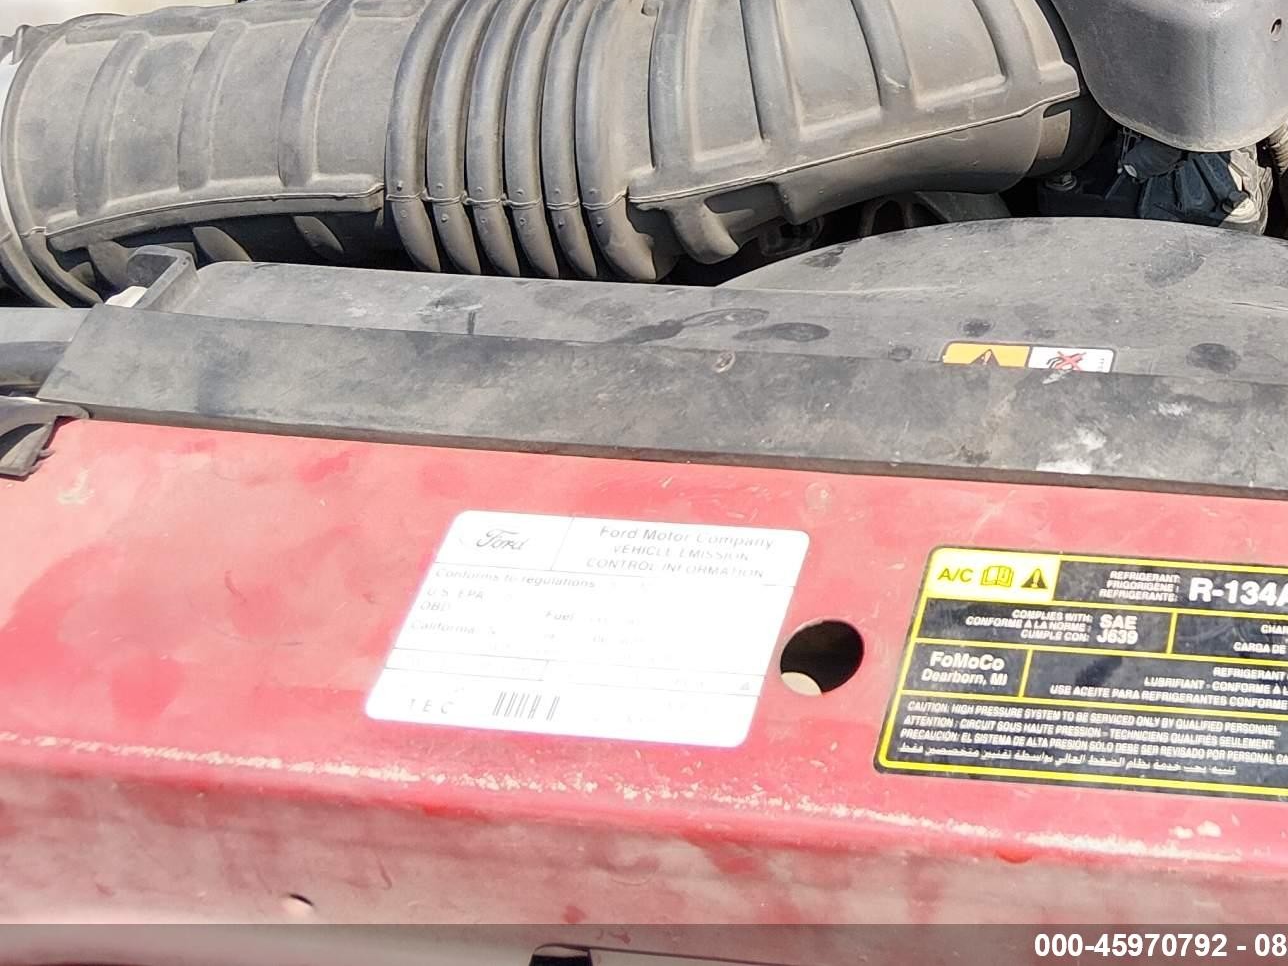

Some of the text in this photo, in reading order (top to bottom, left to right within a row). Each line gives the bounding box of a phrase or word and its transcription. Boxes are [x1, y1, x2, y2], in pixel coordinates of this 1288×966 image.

[474, 528, 531, 550] Ford
[598, 526, 690, 542] Ford Motor
[937, 569, 973, 581] A/C
[966, 616, 1085, 631] CONFORME LA NORME
[1011, 610, 1093, 622] COMPLIES WITH:
[1099, 614, 1137, 629] SAE
[1020, 630, 1062, 640] CUMPLE
[1096, 629, 1138, 644] J639
[1272, 644, 1286, 653] DE
[929, 651, 1006, 670] FoMoCo
[921, 668, 1008, 685] Dearborn, MI
[1213, 667, 1285, 680] REFRIGERANT
[1144, 677, 1204, 689] LUBRIFIANT
[1212, 681, 1270, 693] CONFORME
[1050, 685, 1287, 708] USE ACEITE PARA REFRIGERANTES CONFORME
[951, 704, 974, 714] HIGH
[975, 705, 1022, 717] PRESSURE
[1024, 708, 1061, 720] SYSTEM
[1061, 710, 1074, 721] TO
[1075, 712, 1088, 722] BE
[1089, 713, 1135, 725] SERVICED
[1136, 716, 1159, 727] ONLY
[1161, 718, 1174, 728] BY
[1175, 719, 1223, 731] QUALIFIED
[903, 715, 1169, 741] ATTENTION CIRCUIT SOUS HAUTE PRESSION TECHNICIENS
[960, 732, 1274, 763] EL SISTEMA DE ALTA DEBE SER REVISADO POR PERSONAL
